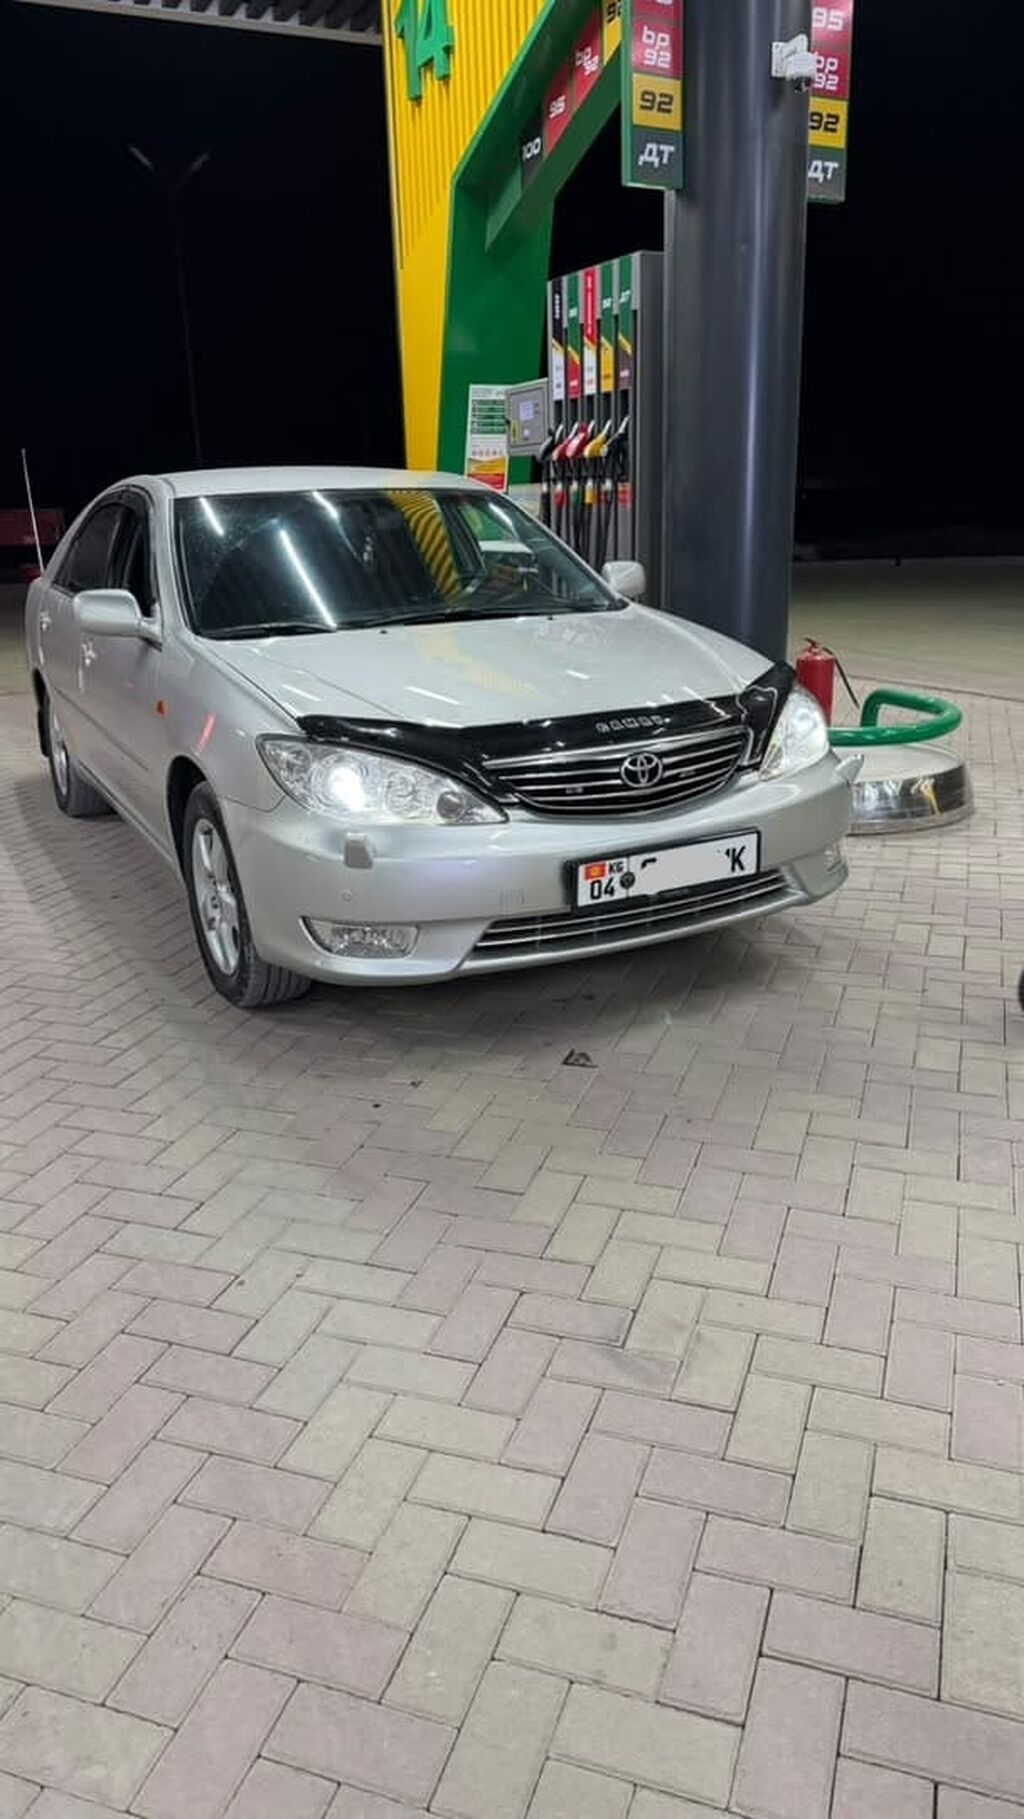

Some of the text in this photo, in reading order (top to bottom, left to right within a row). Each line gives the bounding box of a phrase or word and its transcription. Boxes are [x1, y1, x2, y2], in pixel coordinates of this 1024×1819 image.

[812, 7, 844, 31] 95
[642, 26, 670, 49] bp
[643, 48, 671, 68] 92
[813, 73, 839, 91] 92
[640, 89, 674, 114] 92
[809, 112, 840, 133] 92
[522, 137, 541, 161] 100
[638, 142, 675, 168] ДТ
[808, 160, 839, 183] ДТ
[608, 861, 624, 874] KG
[590, 877, 615, 900] 04
